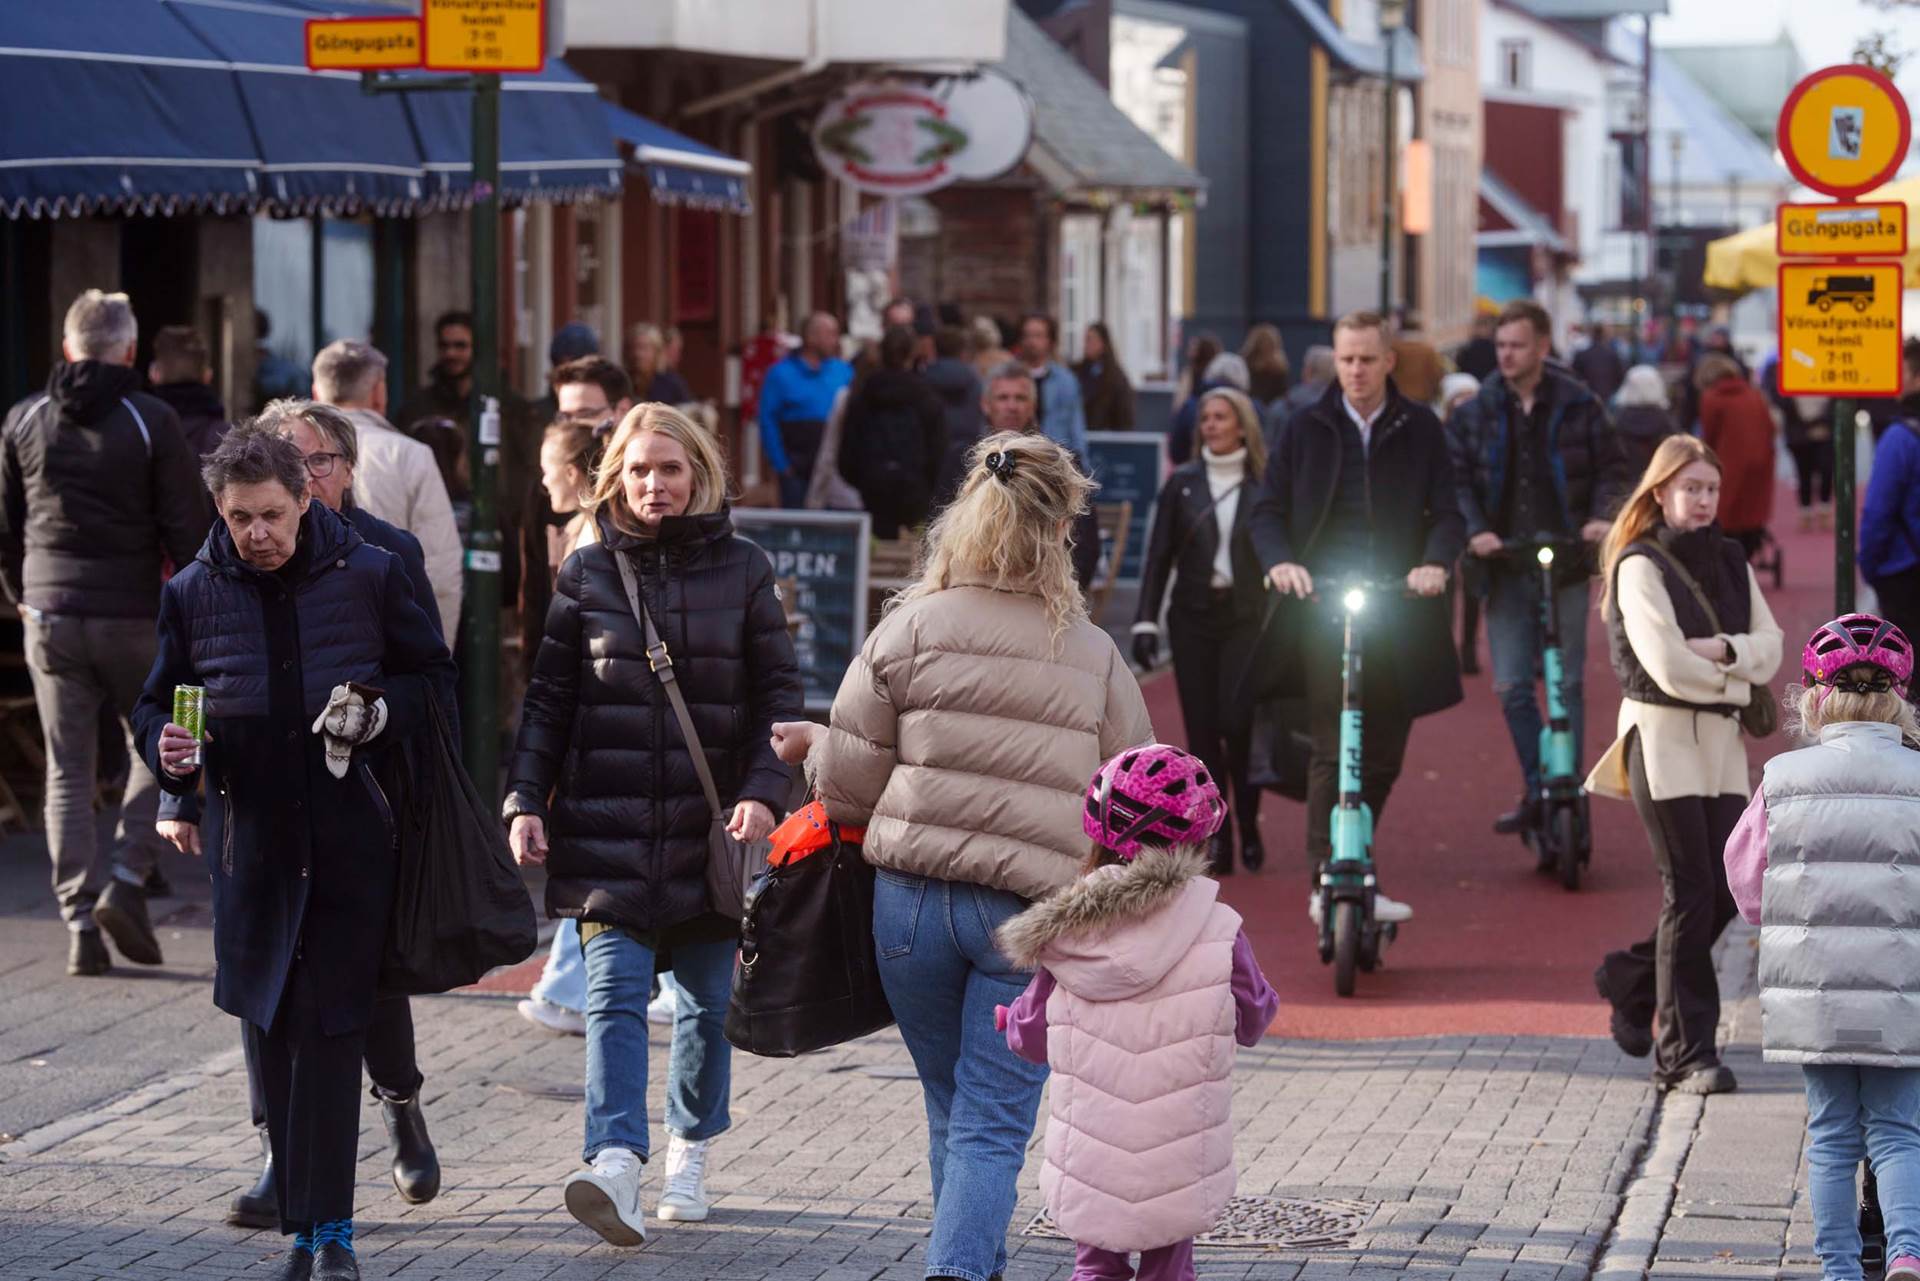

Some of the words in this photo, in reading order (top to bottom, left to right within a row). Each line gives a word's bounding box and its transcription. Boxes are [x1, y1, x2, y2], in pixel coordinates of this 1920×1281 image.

[315, 34, 415, 52] Göngugata
[1788, 220, 1897, 239] Göngugata
[1786, 315, 1895, 331] Vöruafgreiðsla
[1818, 334, 1863, 347] heimil
[1827, 351, 1853, 364] 7-11
[1821, 370, 1859, 384] (8-11)
